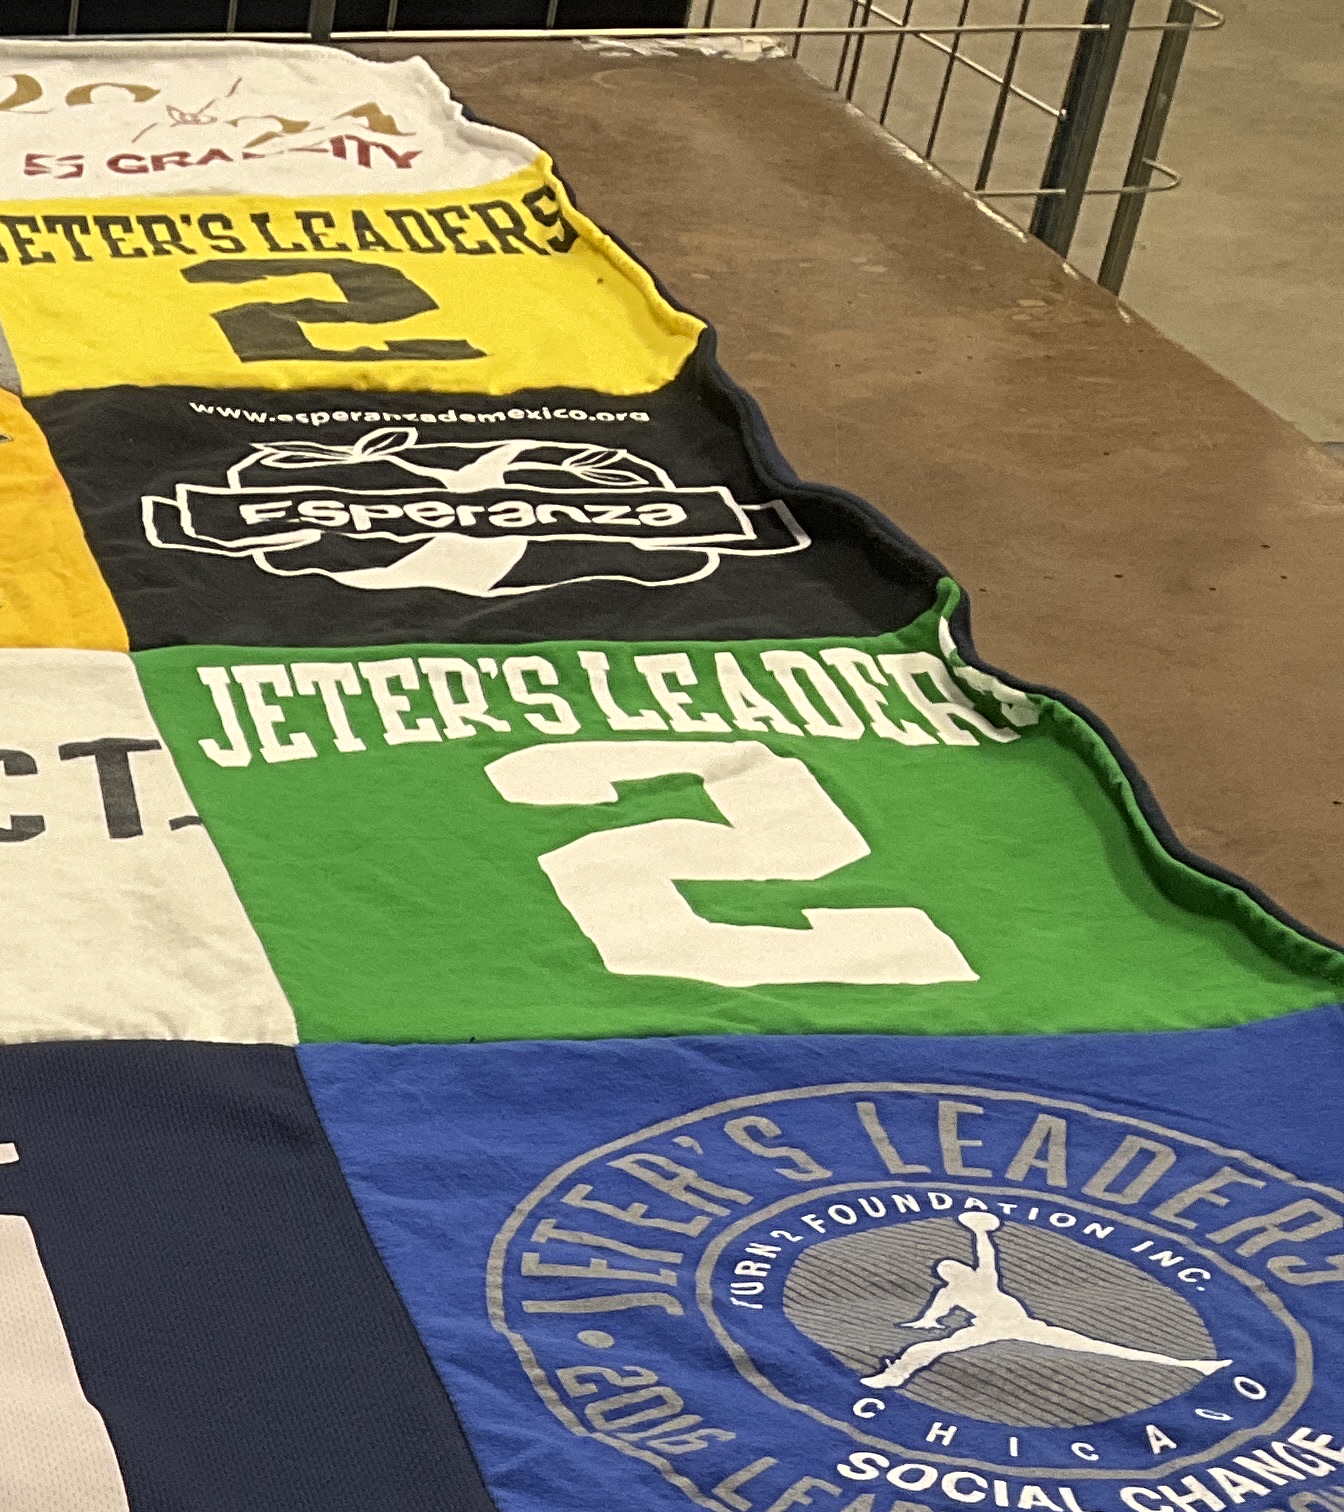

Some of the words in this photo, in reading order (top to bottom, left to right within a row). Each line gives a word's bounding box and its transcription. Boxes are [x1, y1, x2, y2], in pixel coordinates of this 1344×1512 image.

[106, 134, 423, 175] GRAITY
[249, 184, 580, 256] LEADERS
[179, 259, 489, 363] 2
[189, 401, 651, 427] www.esperanzademexico.org
[239, 499, 687, 531] Esperanza
[197, 655, 581, 768] JETER'S
[483, 740, 981, 988] 2
[520, 1113, 833, 1317] JETER'S
[800, 1191, 1116, 1240] FOUNDATION
